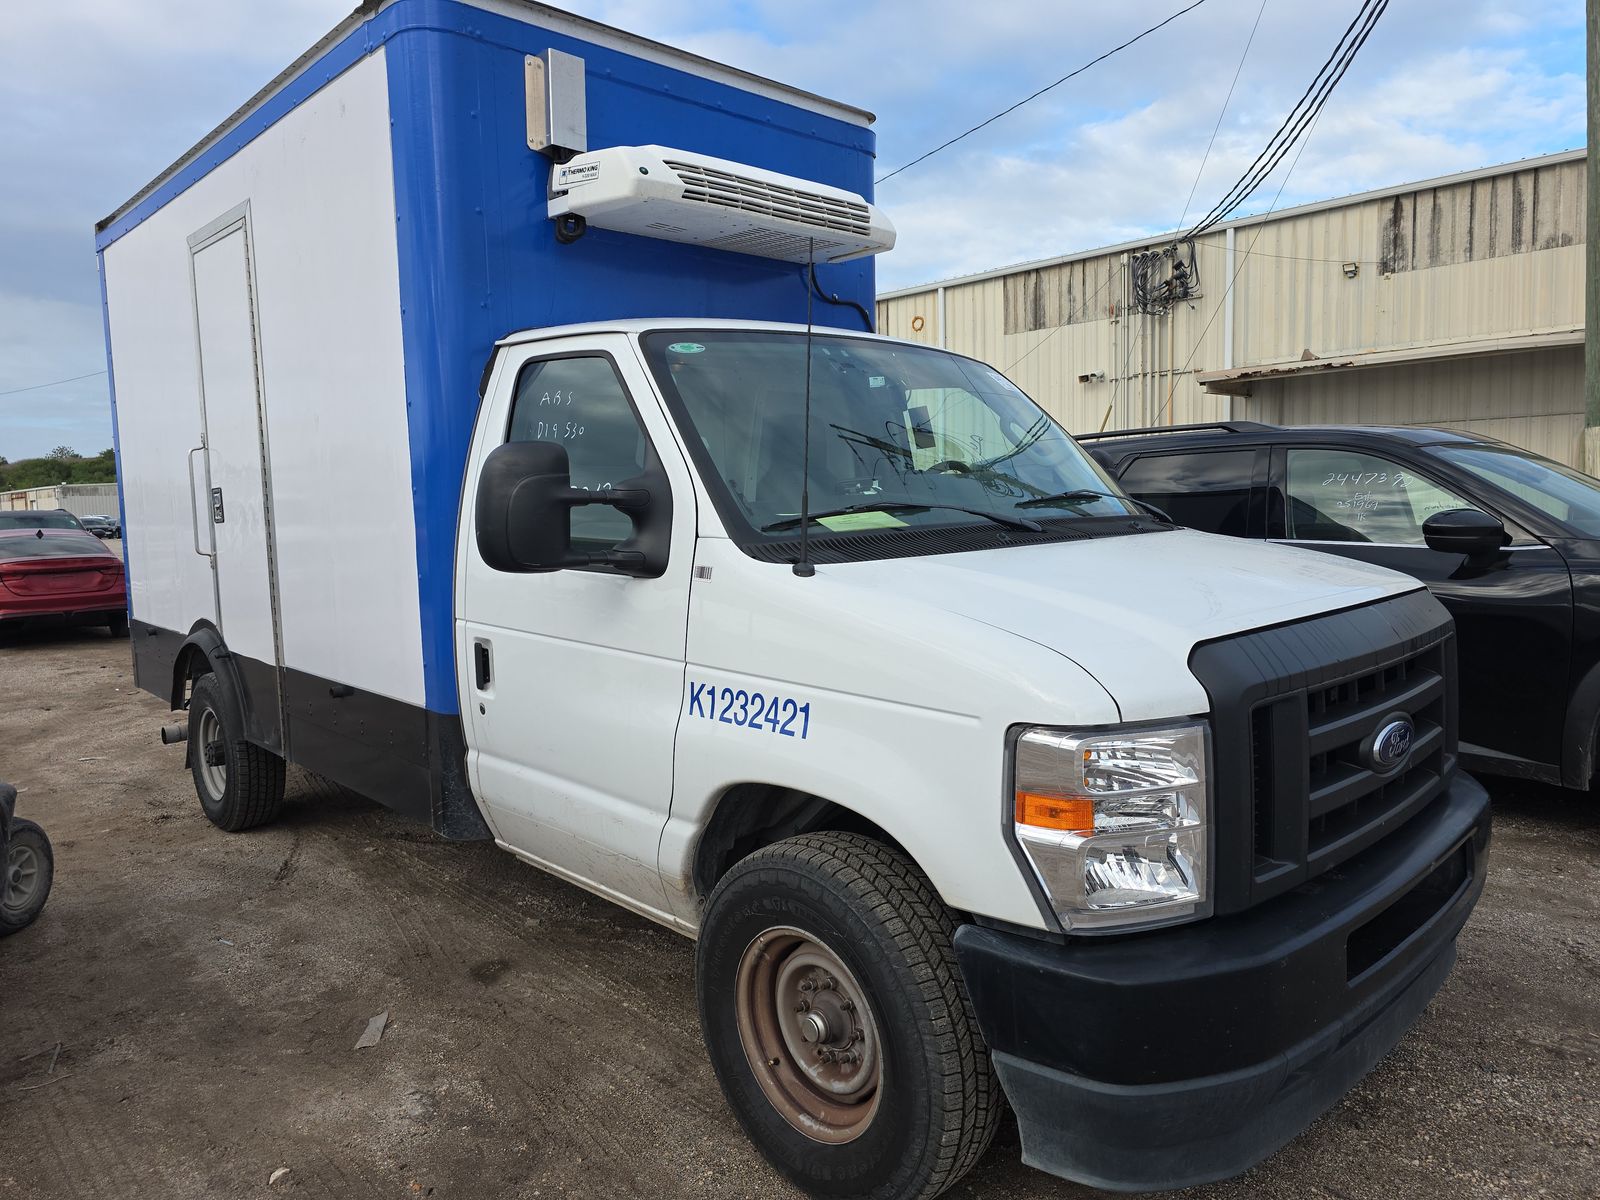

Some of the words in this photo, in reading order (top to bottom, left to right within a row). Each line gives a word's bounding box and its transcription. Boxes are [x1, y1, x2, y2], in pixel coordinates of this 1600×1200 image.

[568, 167, 587, 175] THERMO
[689, 681, 810, 739] K1232421
[1388, 728, 1410, 757] Ford
